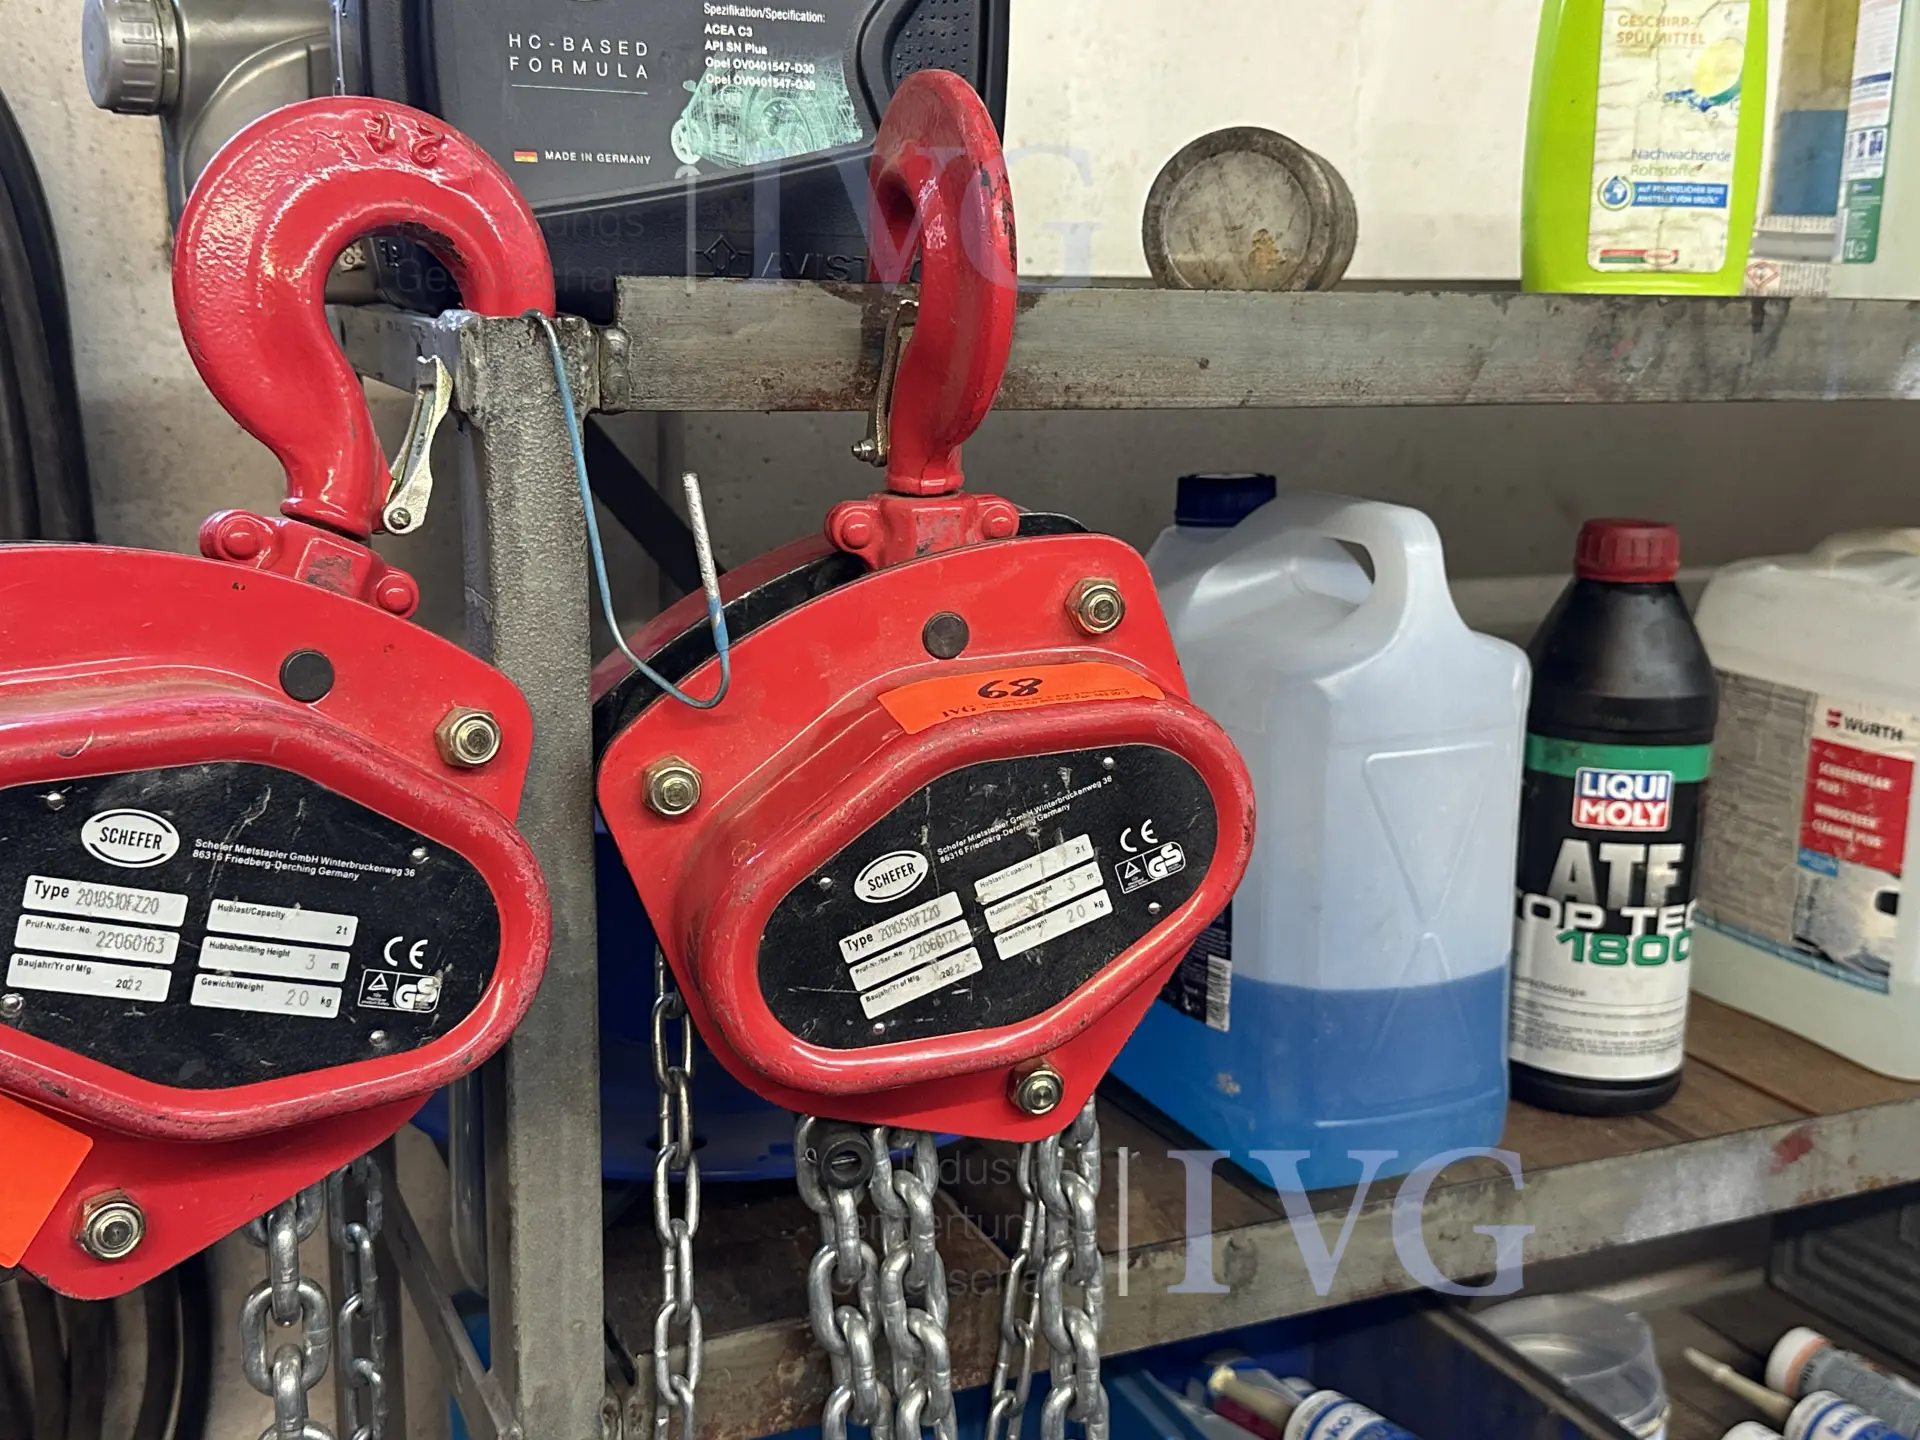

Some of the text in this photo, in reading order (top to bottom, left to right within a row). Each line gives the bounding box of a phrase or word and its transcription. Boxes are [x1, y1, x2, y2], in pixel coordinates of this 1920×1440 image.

[704, 3, 826, 23] Spezifikation/Specification:
[704, 23, 753, 37] ACEA C3
[1616, 29, 1705, 45] SPÜLMITTEL
[508, 33, 648, 57] HC-BASED
[705, 40, 768, 54] API SN Plus
[509, 57, 648, 79] FORMULA
[705, 57, 815, 74] Opel OV0401547-D30
[706, 73, 731, 86] Opel
[545, 151, 651, 165] MADE IN GERMANY
[1631, 149, 1731, 161] Nachwachsende
[977, 677, 1043, 699] 68
[1580, 772, 1666, 799] LIQUI
[1037, 803, 1071, 825] Germany
[1578, 802, 1665, 827] MOLY
[99, 827, 162, 850] SCHEFER
[193, 849, 223, 861] 86316
[318, 866, 360, 881] Germany
[195, 839, 233, 852] Schefer
[234, 843, 289, 859] Mietstapler
[290, 851, 319, 864] GmbH
[402, 868, 416, 877] 36
[867, 862, 916, 892] SCHEFER
[1086, 873, 1094, 881] m
[1547, 838, 1686, 909] ATF
[34, 880, 70, 900] Type
[217, 904, 286, 920] Hublast/Capacity
[1067, 904, 1086, 924] 20
[1093, 899, 1104, 910] kg
[1521, 893, 1605, 931] OP
[96, 931, 166, 954] 22060163
[844, 931, 874, 952] Type
[65, 964, 75, 972] of
[266, 947, 290, 959] Height
[304, 953, 316, 970] 3
[331, 961, 339, 970] m
[115, 979, 143, 991] 2022
[201, 977, 332, 1008] Gewicht/Weight 20 kg
[900, 979, 909, 988] of
